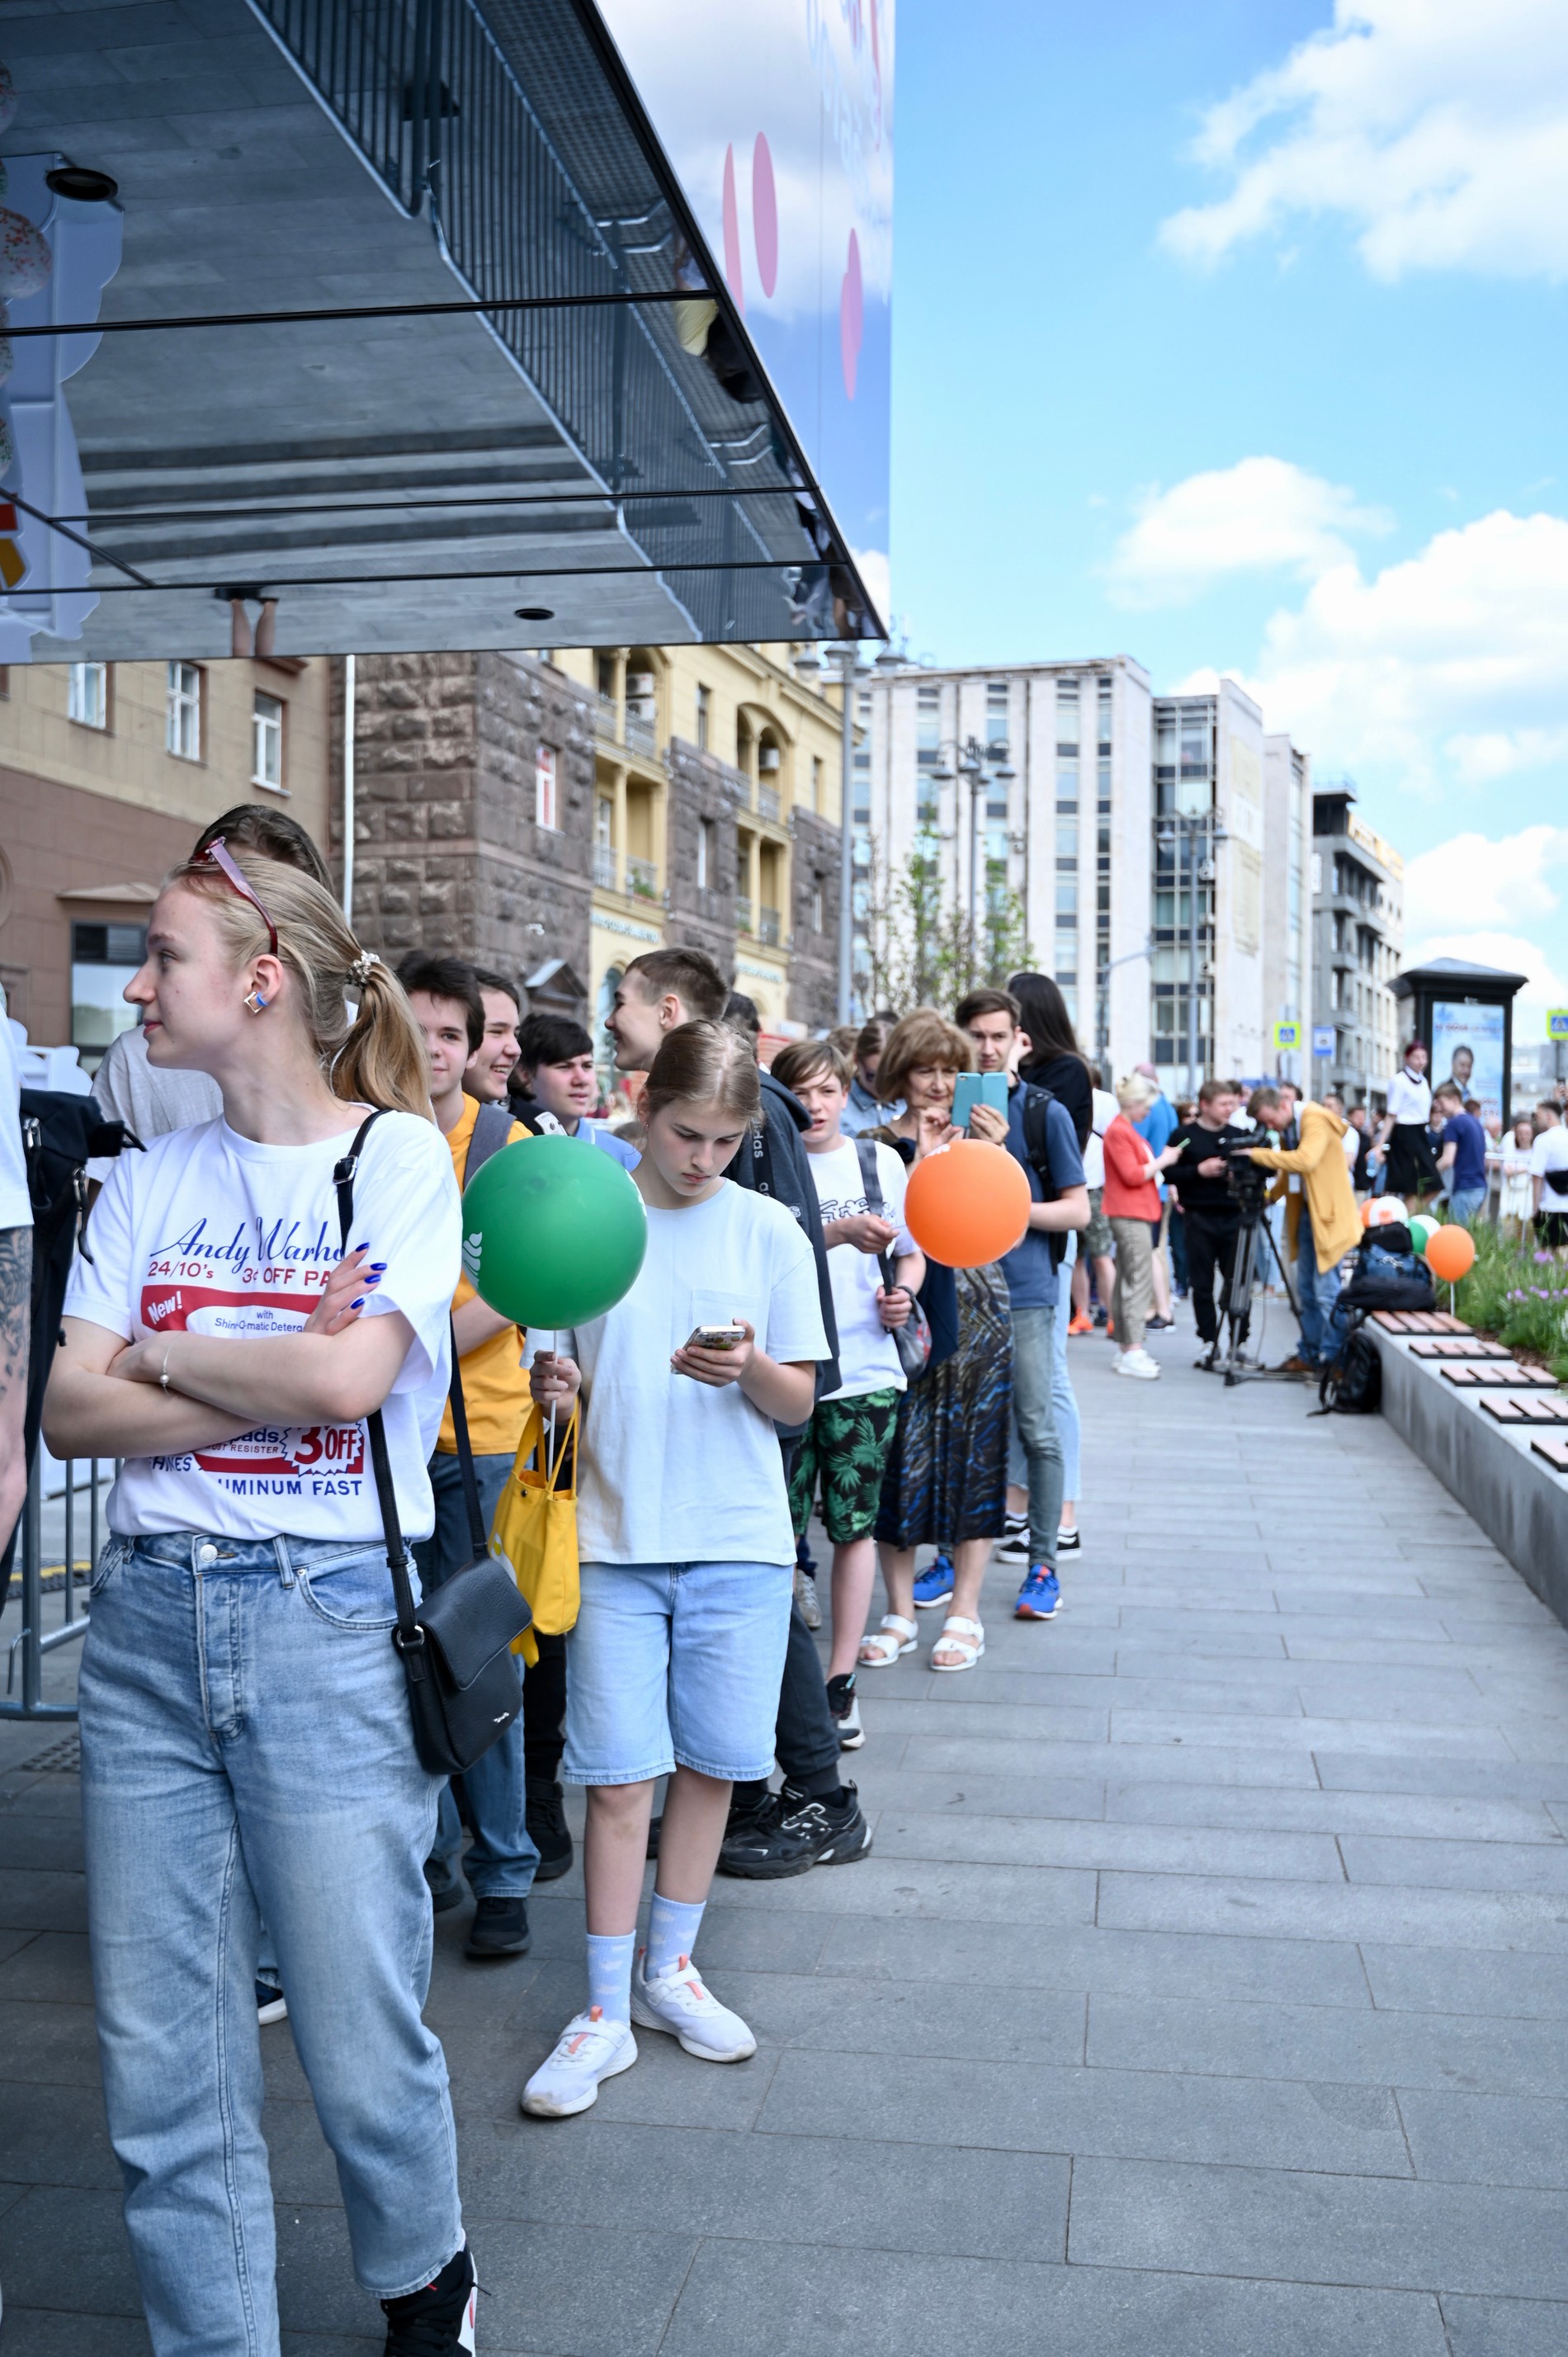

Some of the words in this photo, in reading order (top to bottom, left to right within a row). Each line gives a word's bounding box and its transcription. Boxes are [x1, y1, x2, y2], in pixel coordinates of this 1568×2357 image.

[149, 1217, 250, 1274] Andy
[147, 1260, 215, 1280] 24/10's
[263, 1267, 296, 1285] OFF
[147, 1290, 183, 1325] New!
[256, 1310, 274, 1320] with
[230, 1443, 280, 1454] RESISTER
[294, 1426, 324, 1465] 3
[325, 1428, 358, 1461] OFF
[149, 1456, 193, 1472] HINES
[313, 1480, 363, 1496] FAST
